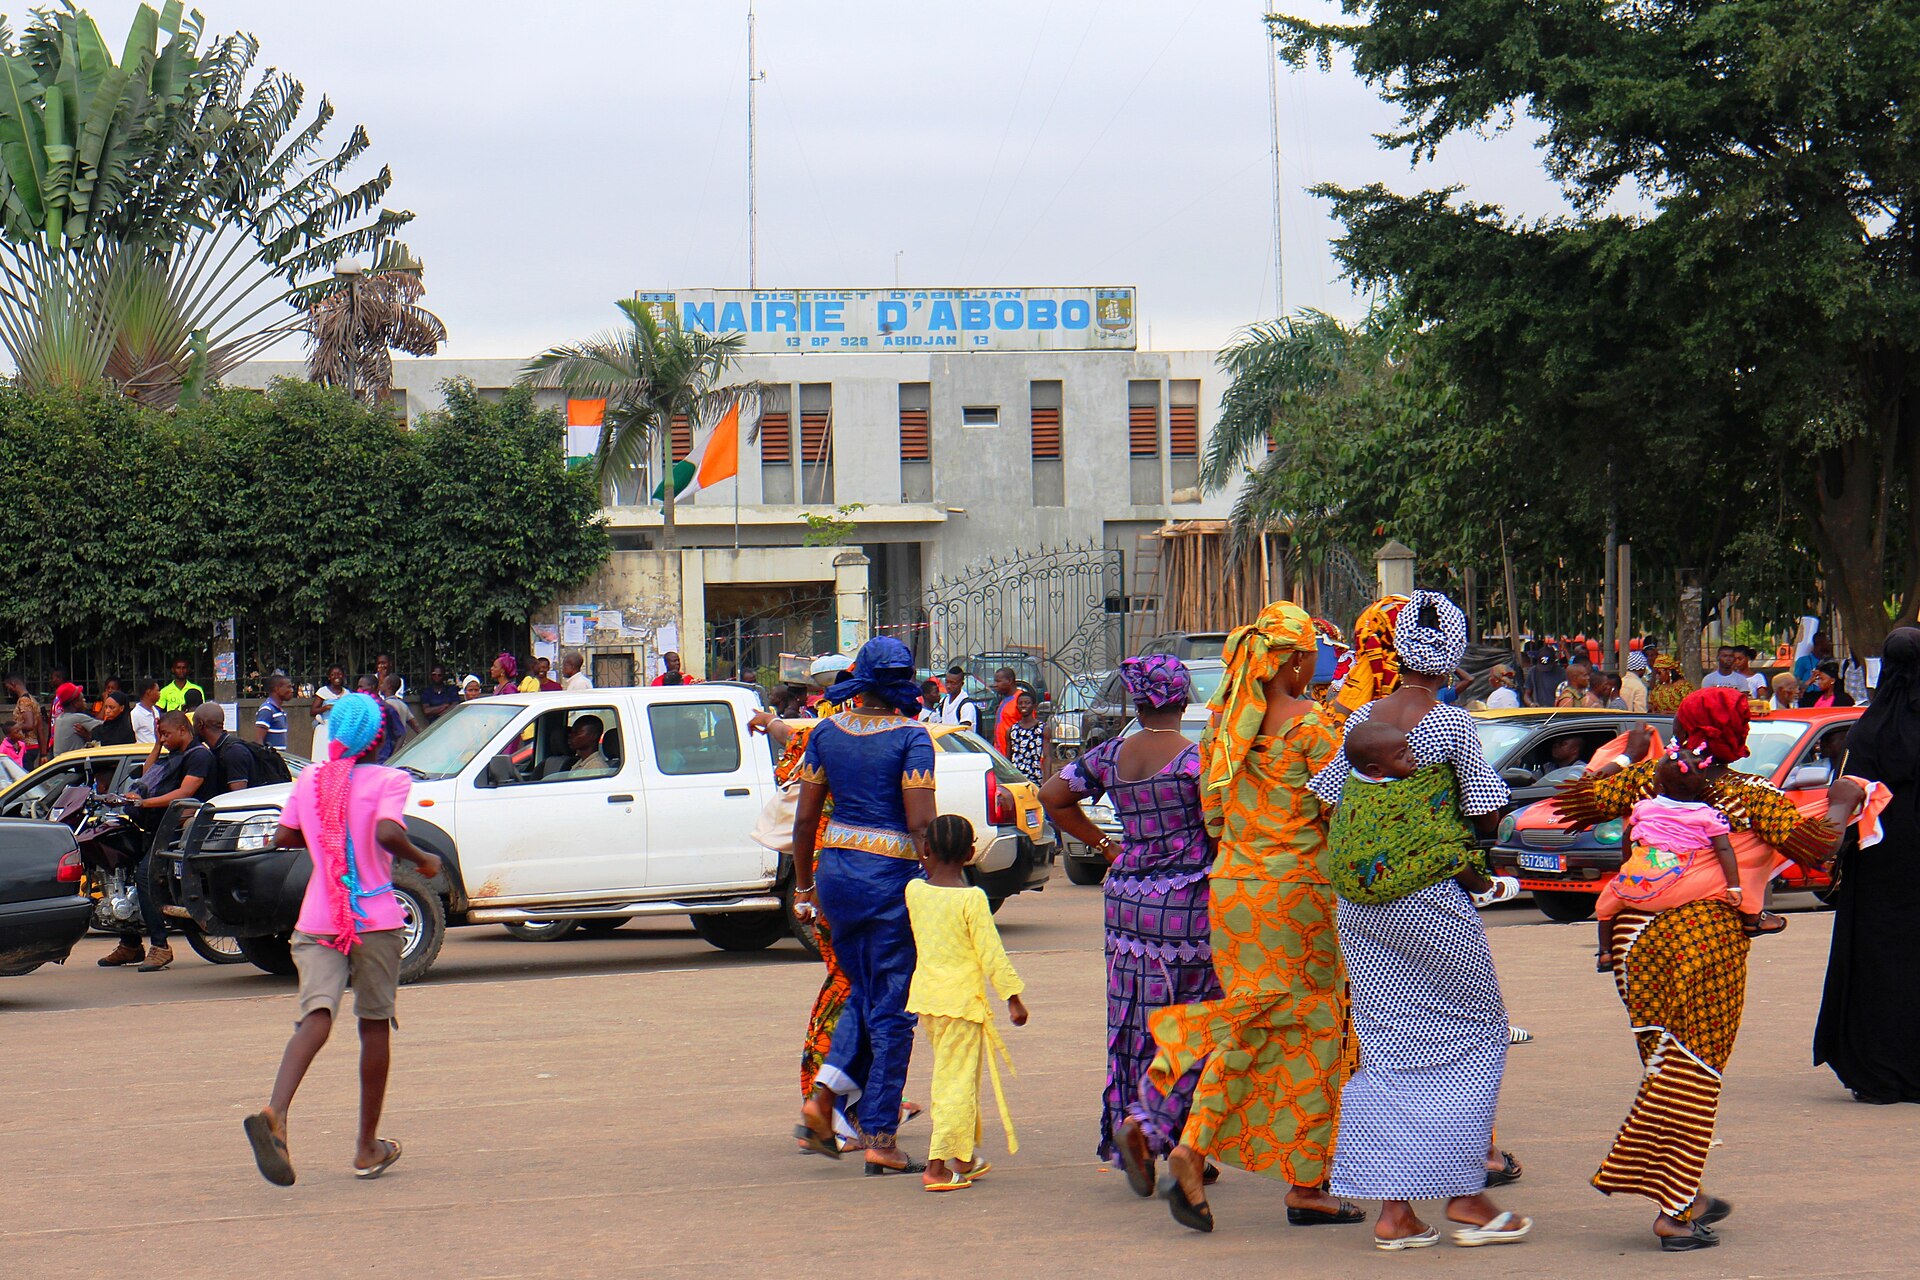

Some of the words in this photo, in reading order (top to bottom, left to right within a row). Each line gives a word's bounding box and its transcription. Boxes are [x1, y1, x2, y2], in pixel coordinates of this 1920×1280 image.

[754, 292, 870, 300] DISTRICT
[890, 291, 1020, 300] D'ABIDJAN
[684, 301, 844, 332] MAIRIE
[878, 300, 1090, 331] D'ABOBO
[786, 337, 800, 346] 13
[811, 337, 830, 346] BP
[840, 337, 868, 346] 928
[884, 336, 957, 346] ABIDJAN
[973, 336, 989, 345] 13
